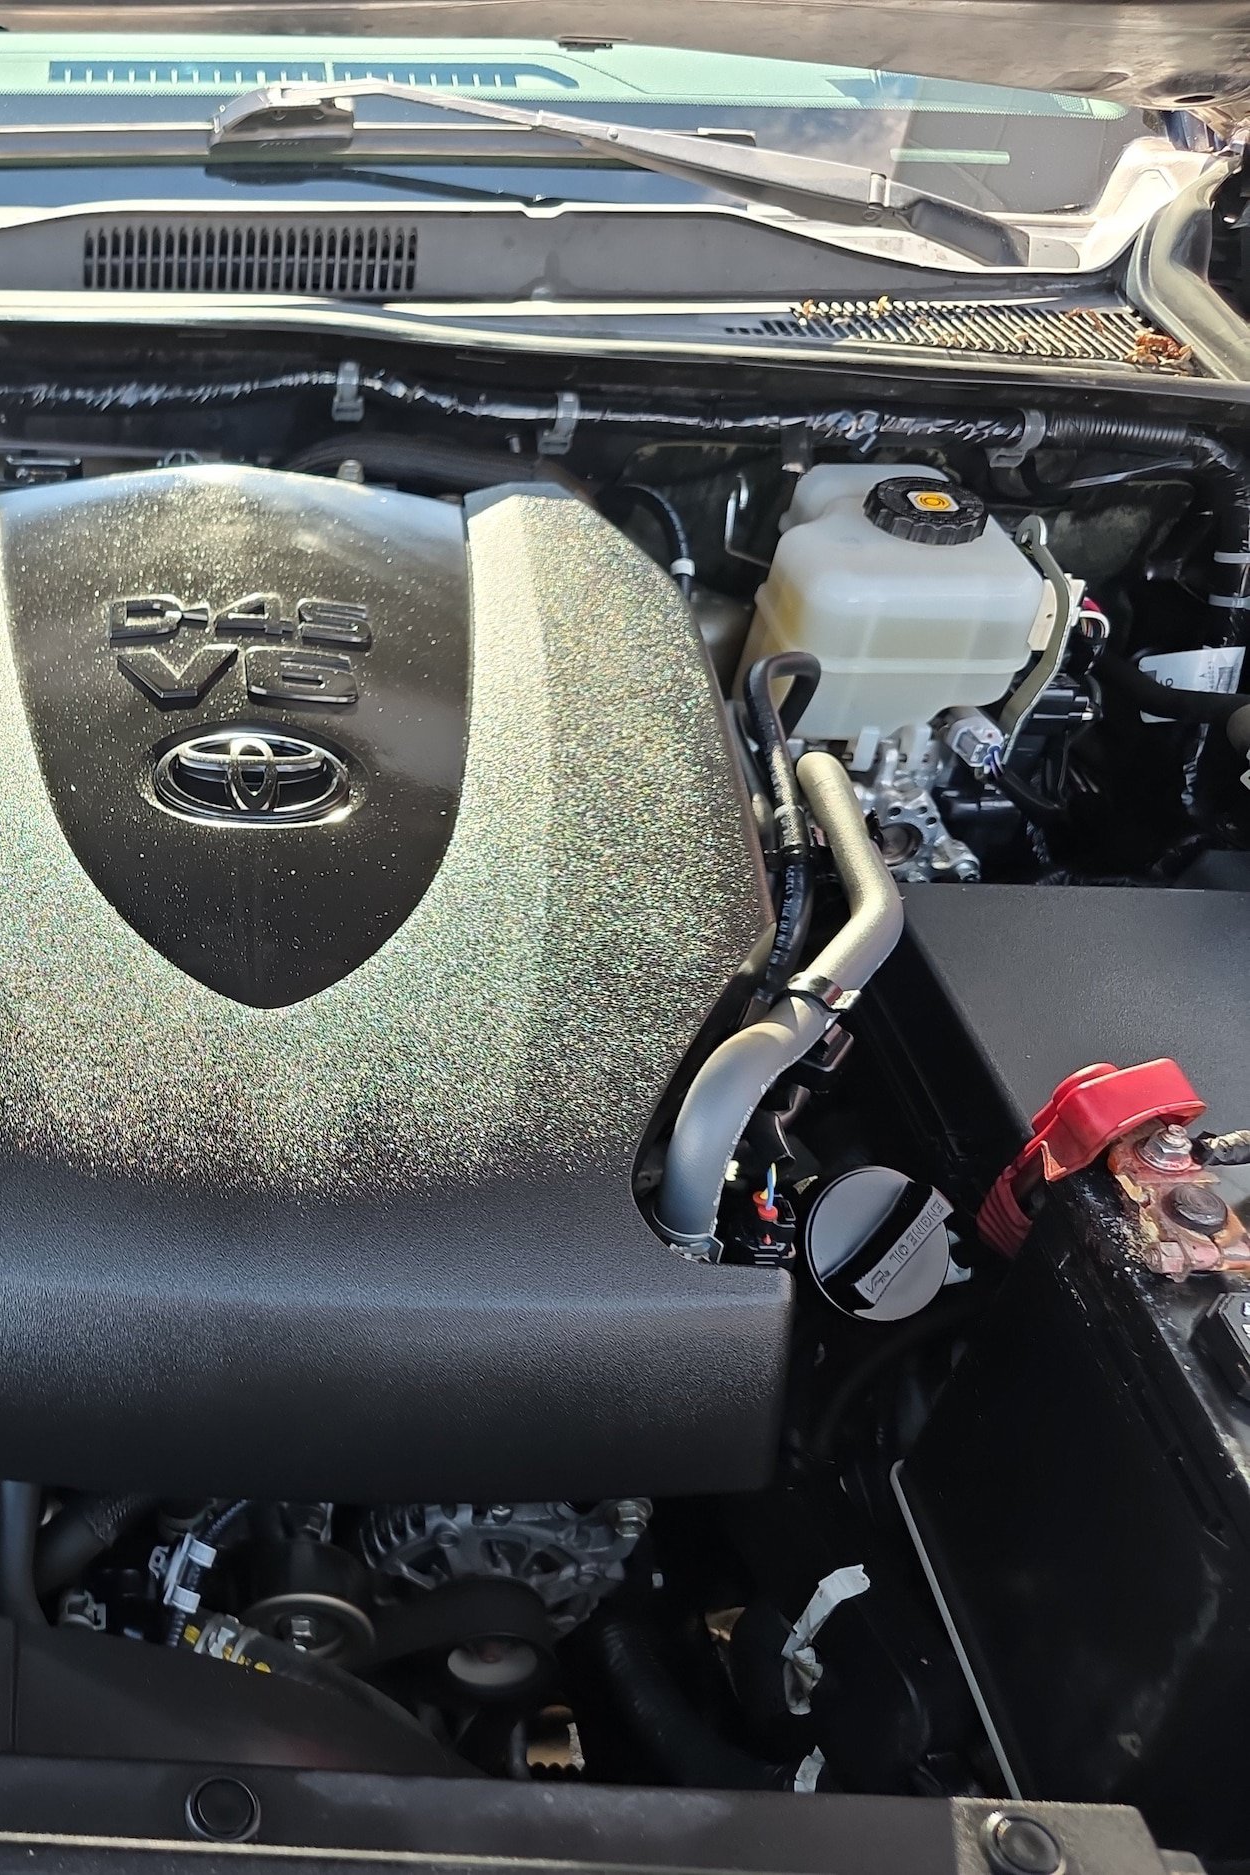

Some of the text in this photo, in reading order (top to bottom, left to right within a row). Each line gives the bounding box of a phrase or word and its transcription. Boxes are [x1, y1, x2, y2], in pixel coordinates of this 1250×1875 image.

[109, 593, 372, 645] D-4S
[116, 643, 360, 704] V6
[906, 1200, 945, 1247] ENGINE
[888, 1243, 909, 1264] OIL
